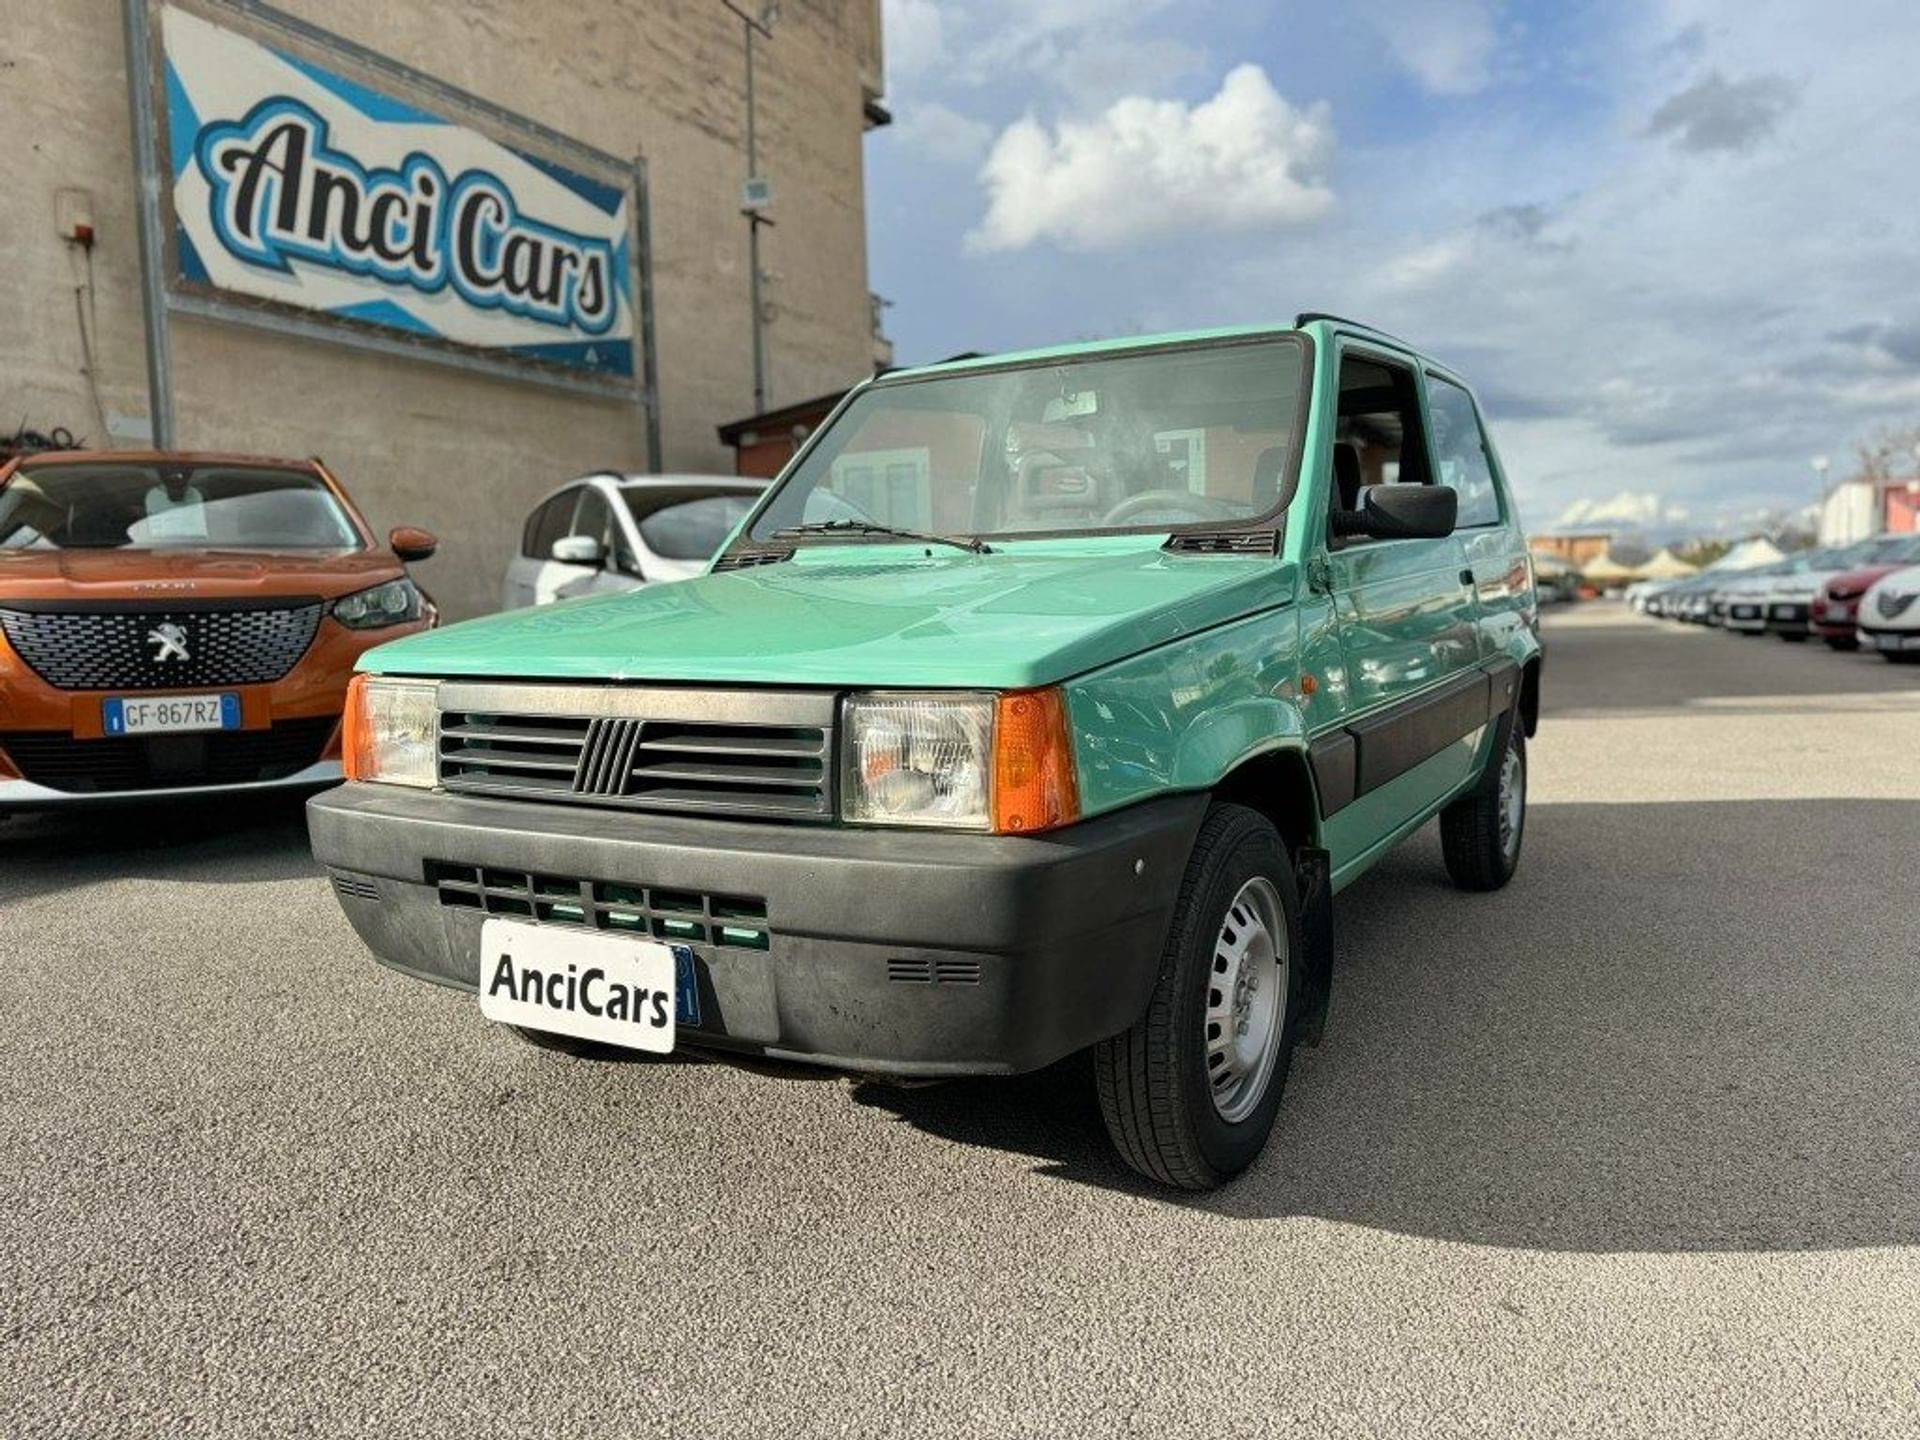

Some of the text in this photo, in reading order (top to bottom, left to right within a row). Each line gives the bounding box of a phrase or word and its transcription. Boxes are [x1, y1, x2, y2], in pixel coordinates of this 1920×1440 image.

[221, 123, 606, 314] Anci Cars
[489, 953, 668, 1028] AnciCars
